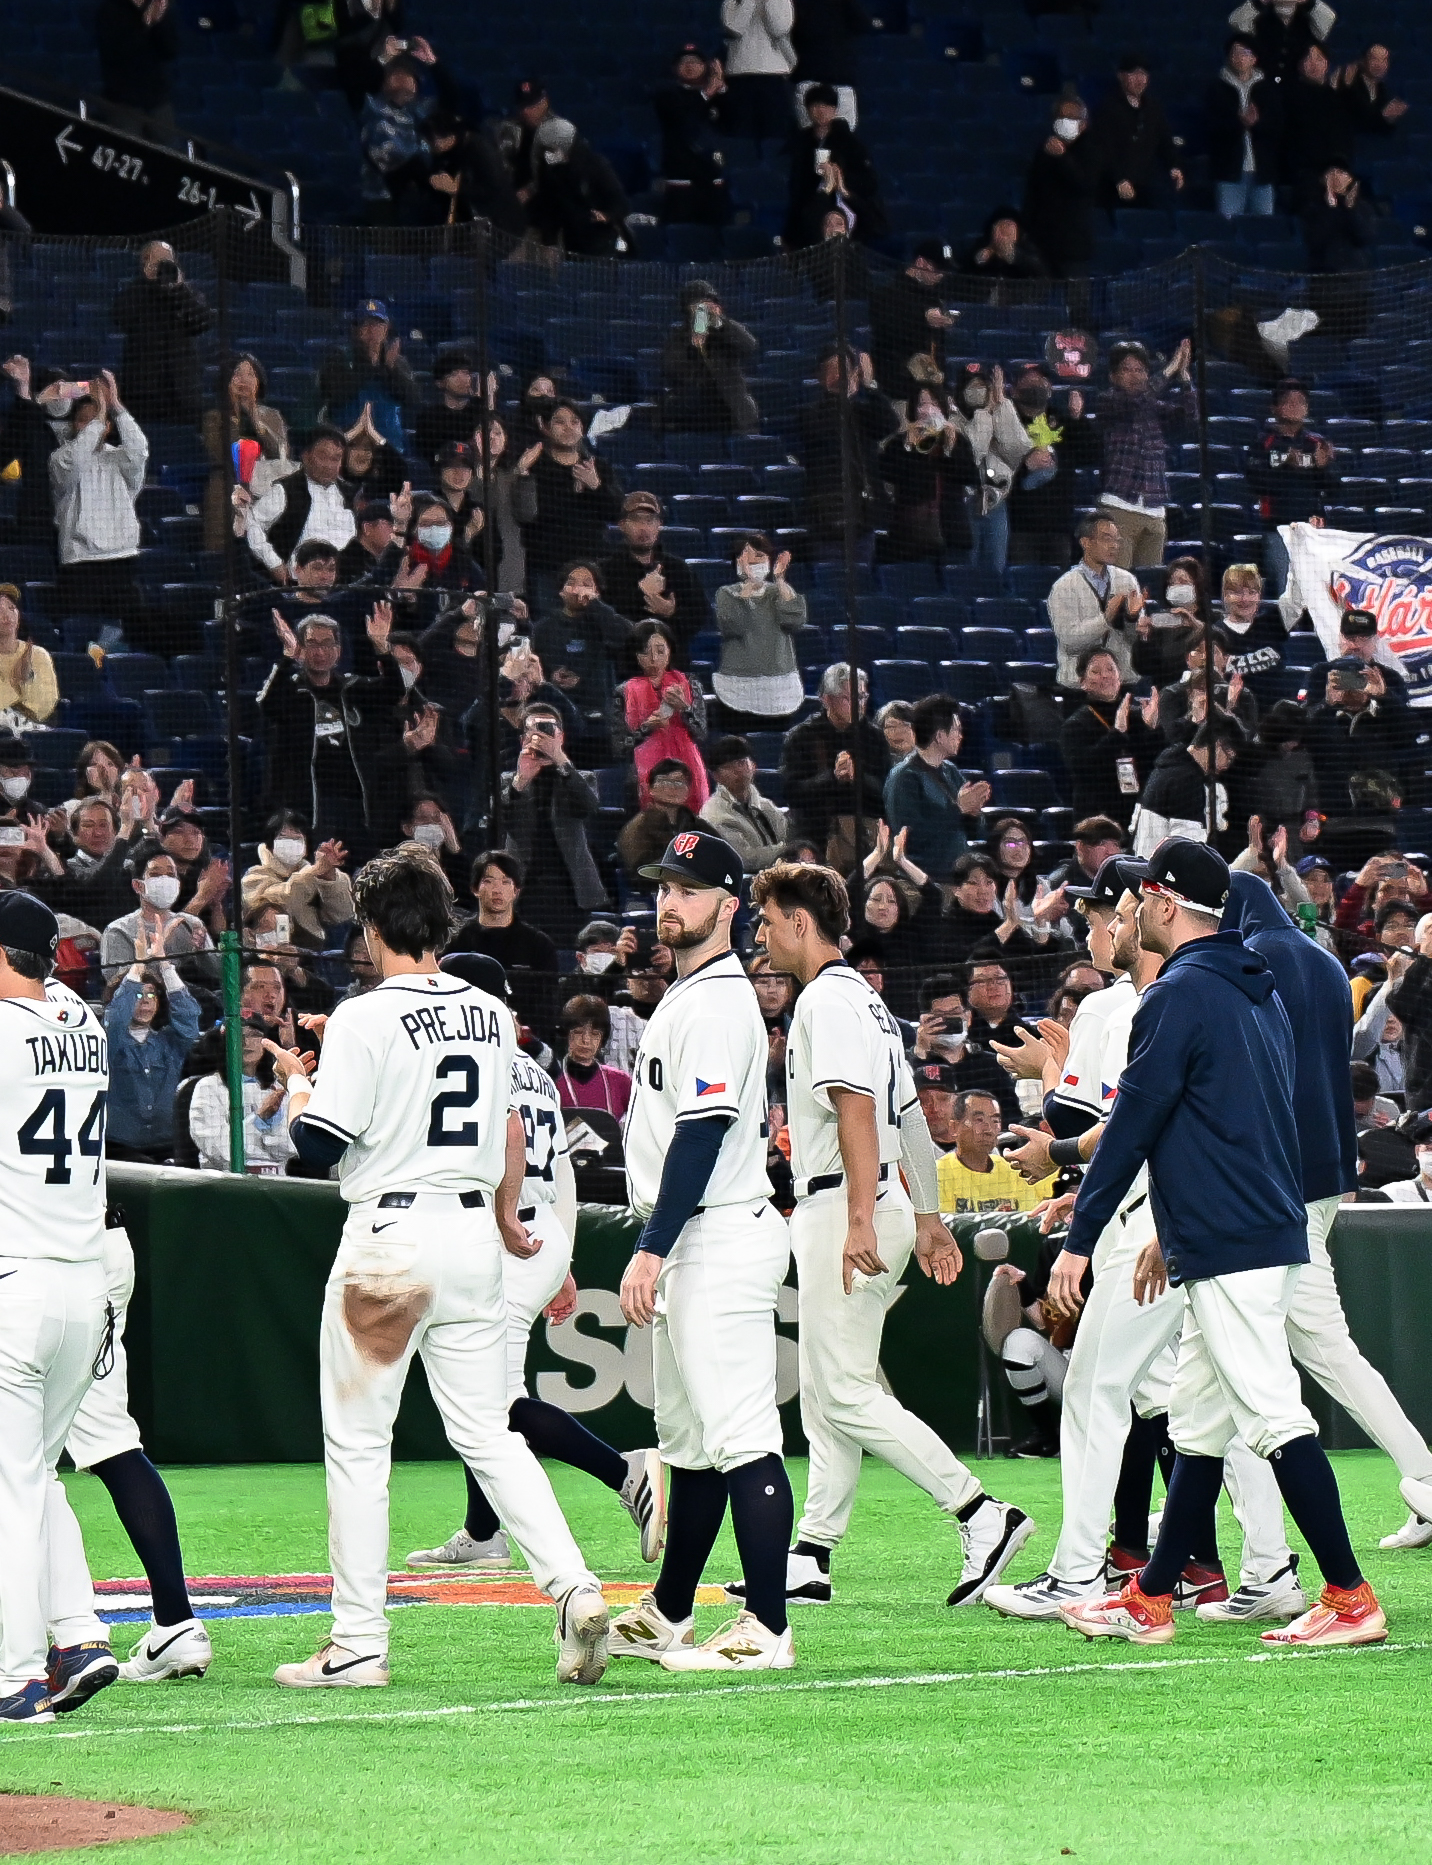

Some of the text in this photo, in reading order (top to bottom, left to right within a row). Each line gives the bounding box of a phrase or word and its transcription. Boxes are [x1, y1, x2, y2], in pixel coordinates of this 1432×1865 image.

[400, 1005, 501, 1050] PREJDA
[17, 1088, 109, 1185] 44
[427, 1055, 479, 1147] 2
